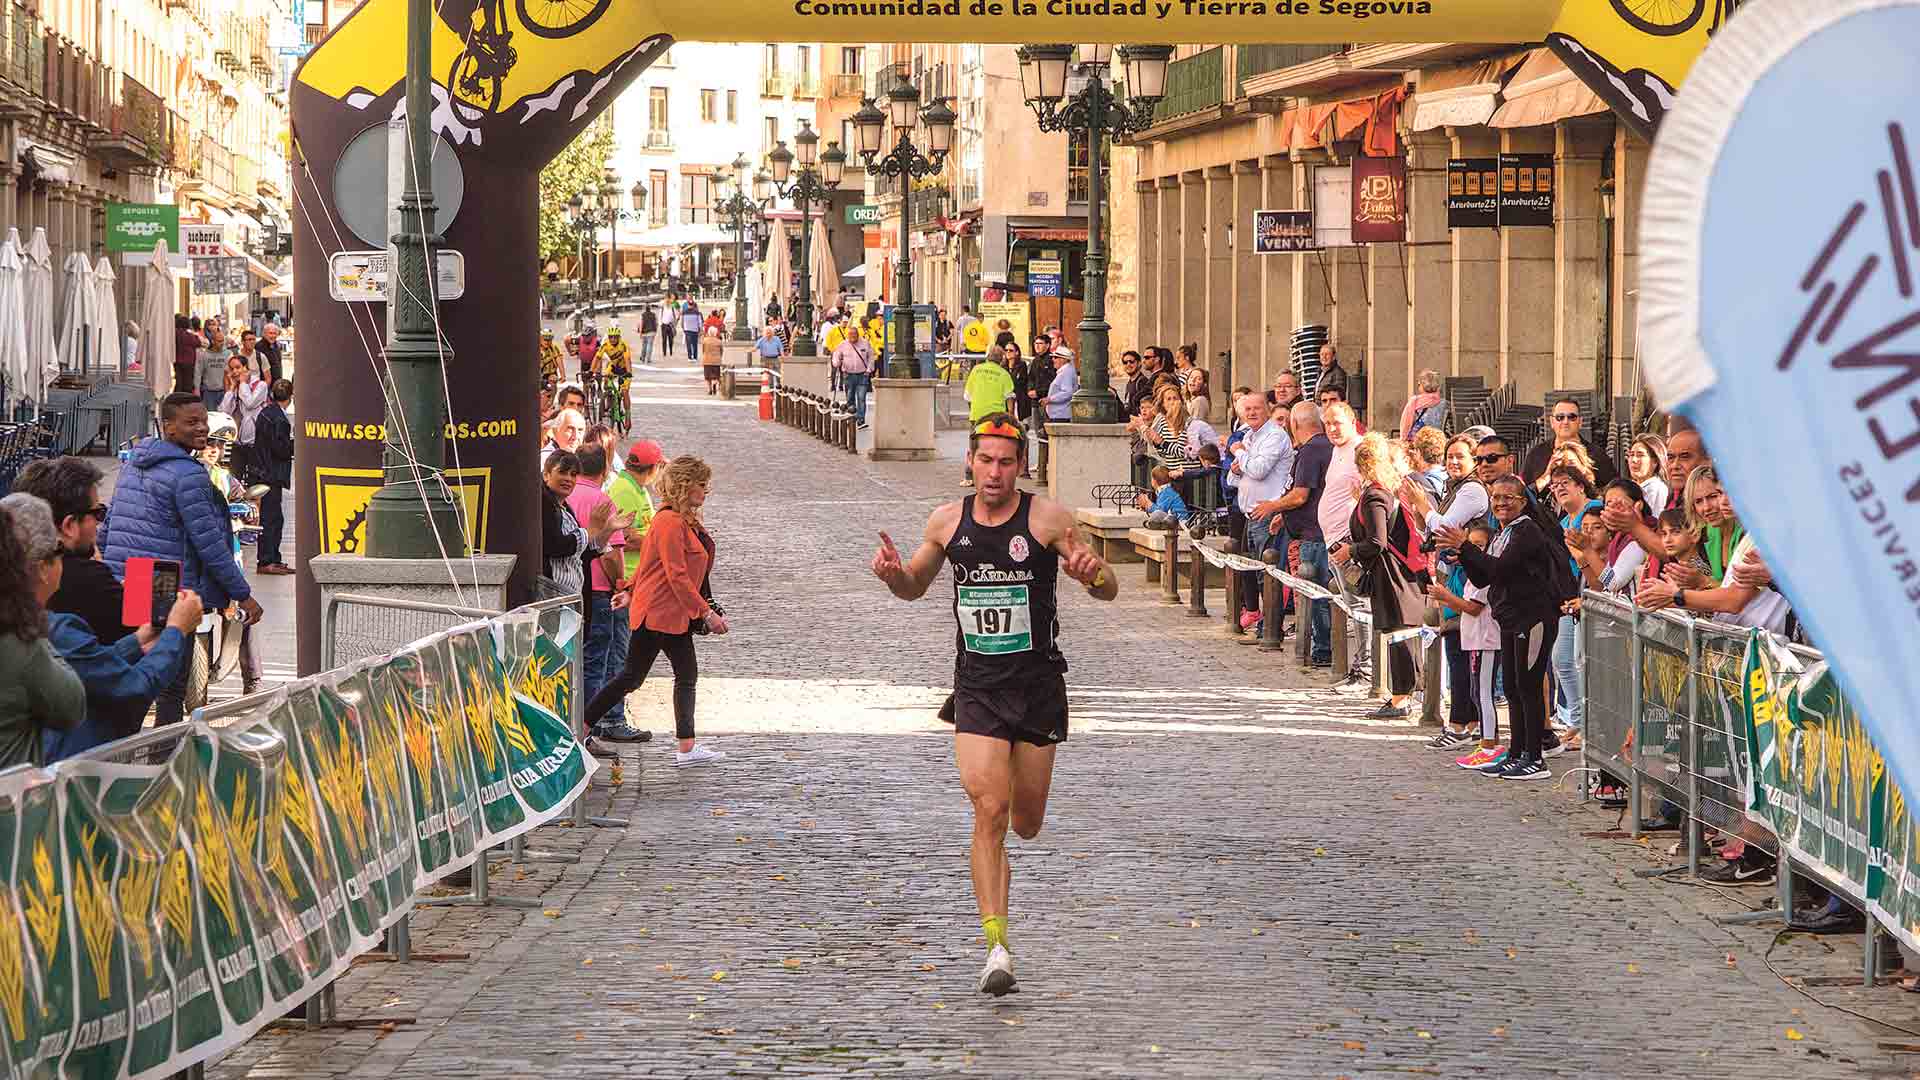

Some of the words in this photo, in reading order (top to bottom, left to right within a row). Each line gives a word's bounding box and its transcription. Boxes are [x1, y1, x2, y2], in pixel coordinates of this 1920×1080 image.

[794, 0, 961, 16] Comunidad
[969, 0, 1004, 16] de
[1012, 0, 1038, 16] la
[1046, 0, 1146, 16] Ciudad
[1153, 1, 1170, 19] y
[1181, 0, 1266, 15] Tierra
[1275, 0, 1311, 15] de
[1319, 0, 1432, 19] Segovia
[1264, 238, 1291, 250] VEN
[971, 607, 1012, 634] 197
